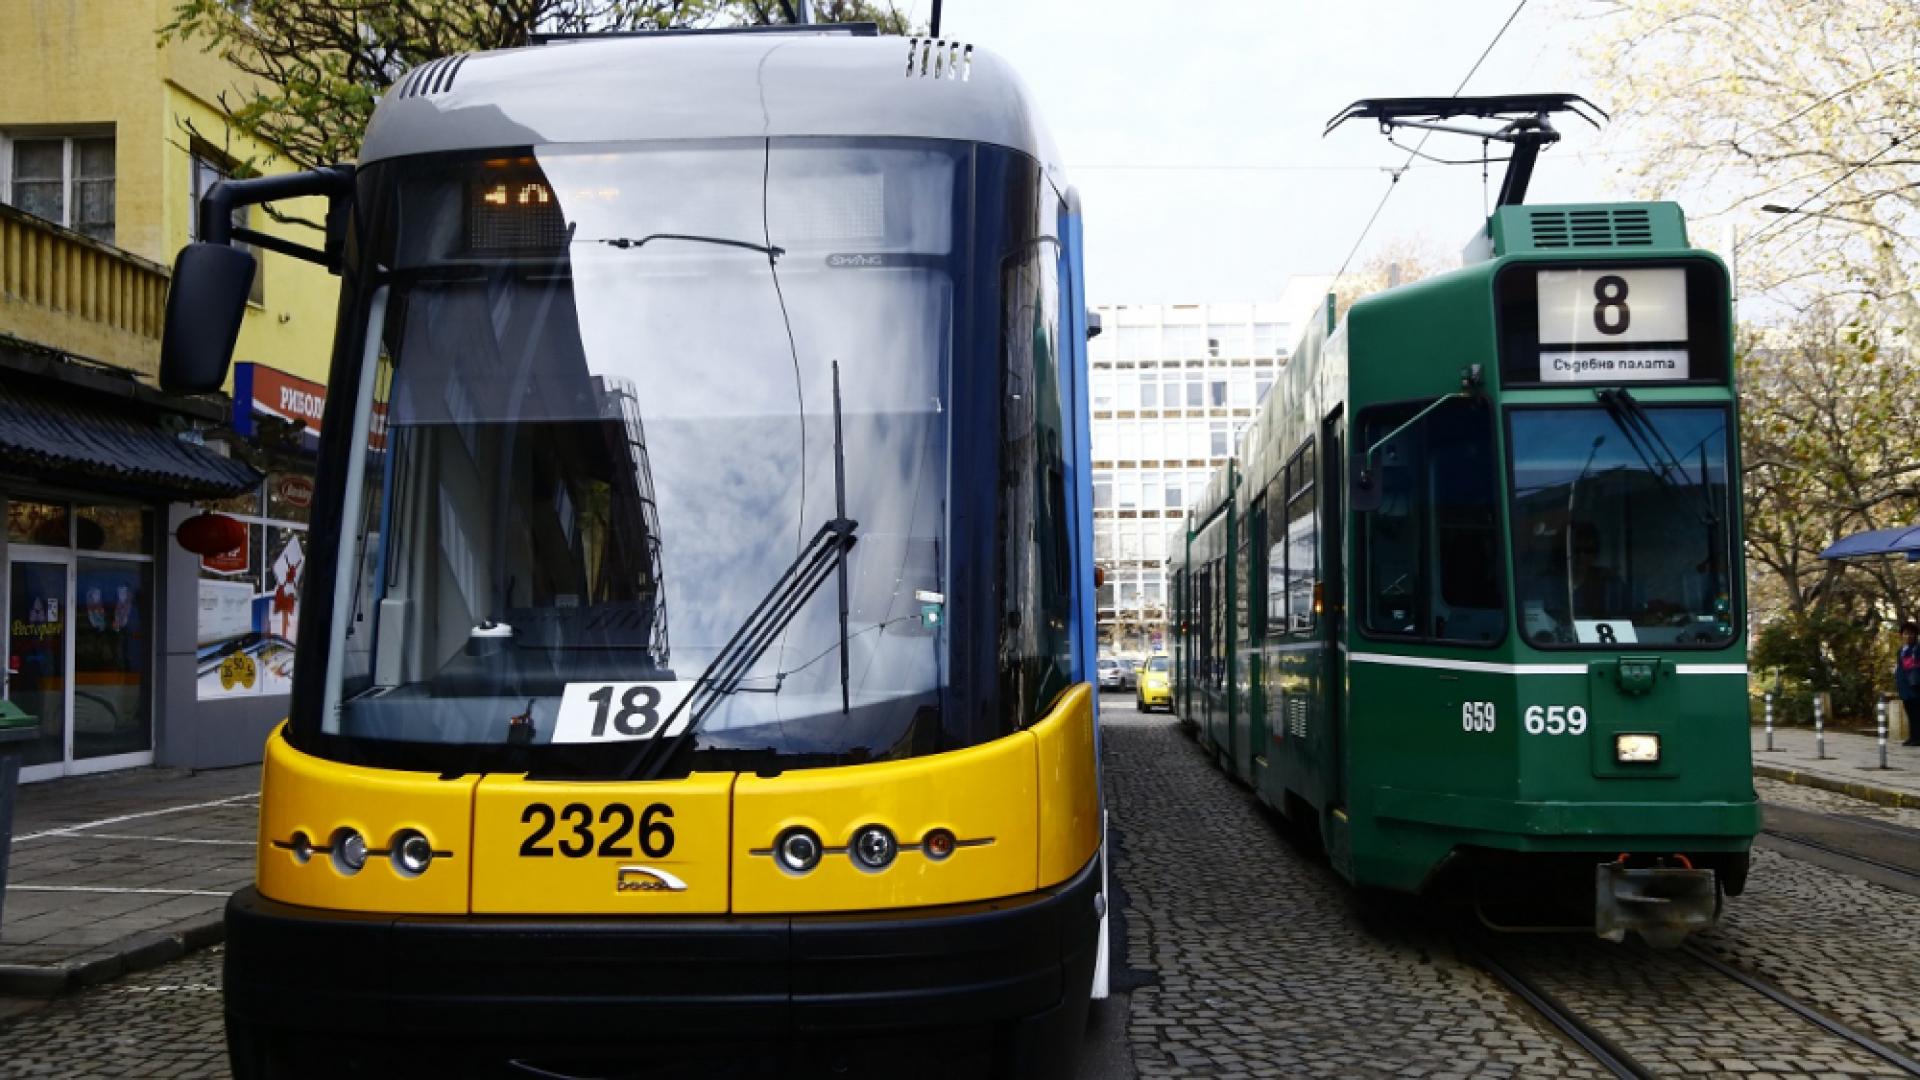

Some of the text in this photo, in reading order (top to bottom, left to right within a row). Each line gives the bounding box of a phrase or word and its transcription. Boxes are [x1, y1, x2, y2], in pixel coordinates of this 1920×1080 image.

[1593, 275, 1631, 336] 8
[1553, 358, 1675, 374] Съдебна палата
[1595, 623, 1617, 644] 8
[588, 685, 662, 737] 18
[1462, 702, 1495, 732] 659
[1524, 705, 1587, 735] 659
[519, 802, 675, 858] 2326
